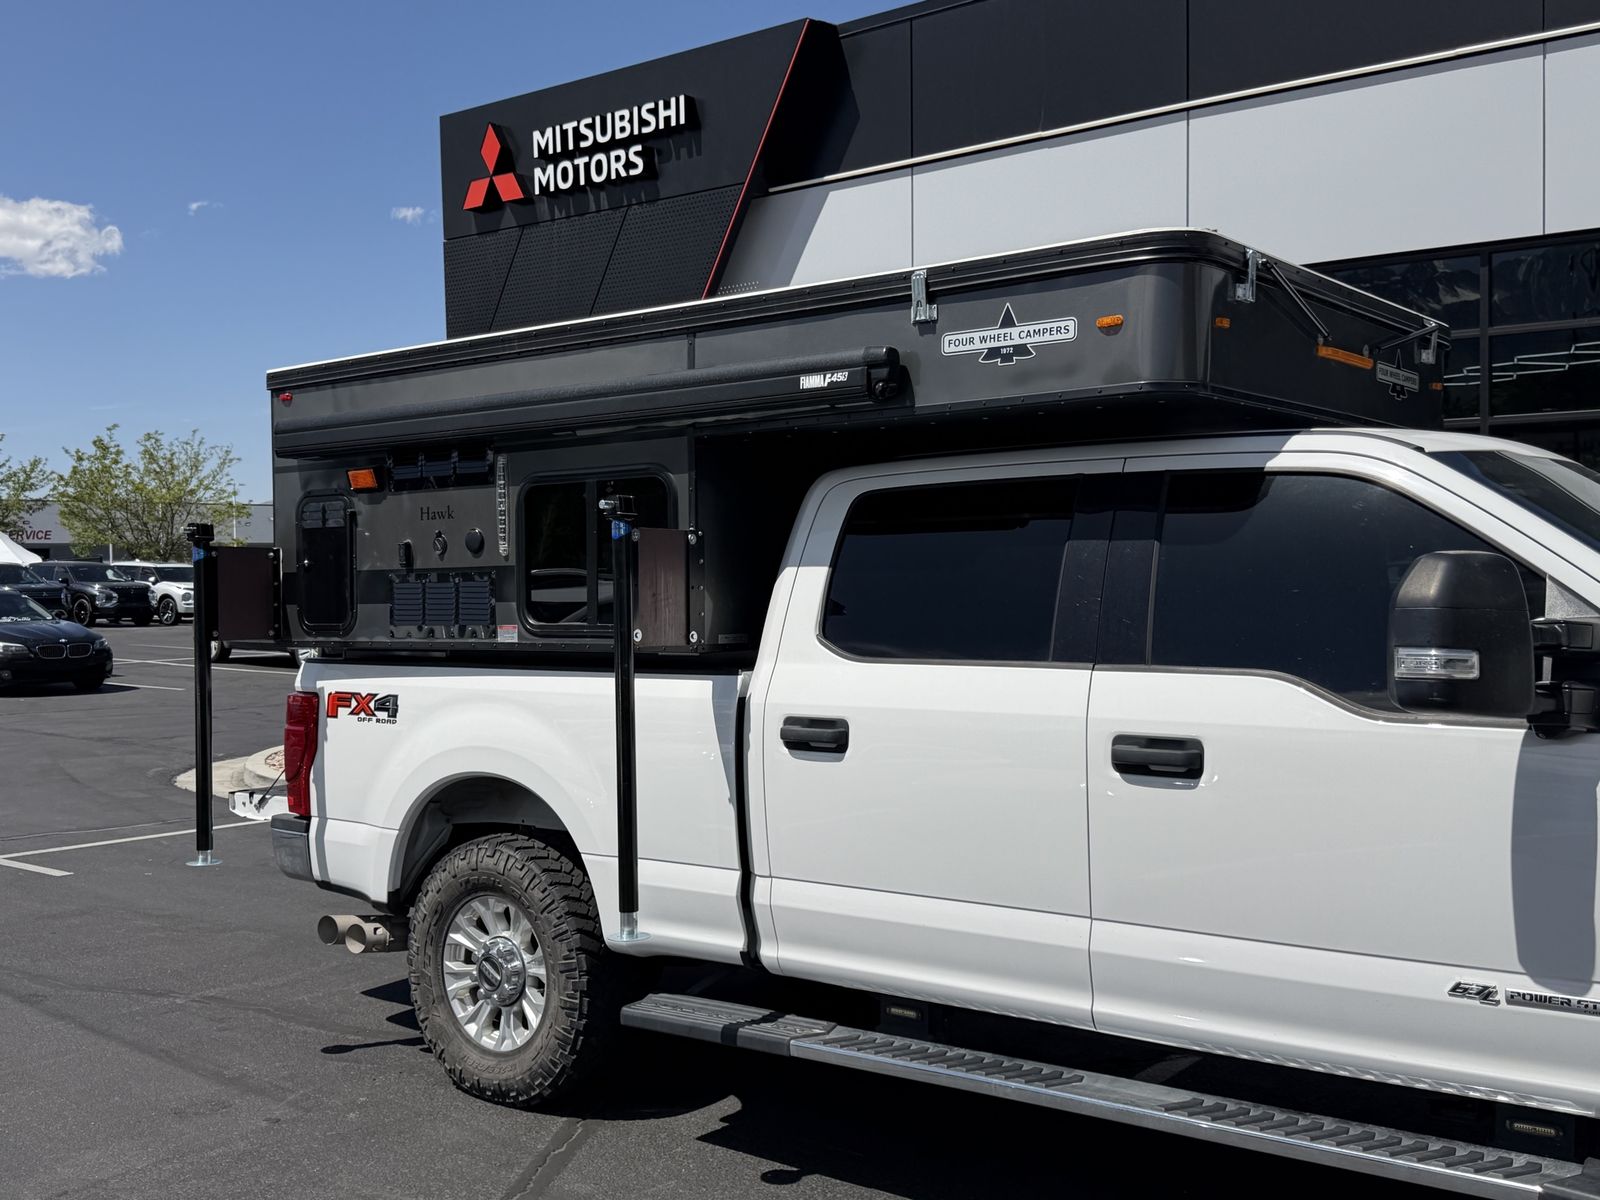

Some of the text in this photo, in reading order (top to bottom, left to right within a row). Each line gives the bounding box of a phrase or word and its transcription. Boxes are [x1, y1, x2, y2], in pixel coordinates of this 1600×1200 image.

[532, 94, 686, 159] MITSUBISHI
[533, 144, 644, 196] MOTORS
[947, 324, 1070, 348] FOUR WHEEL CAMPERS
[799, 374, 824, 390] FIAMMA
[419, 505, 455, 521] Hawk
[8, 529, 53, 541] ERVICE
[326, 690, 399, 719] FX4
[375, 717, 398, 725] ROAD
[1509, 990, 1572, 1008] POWER
